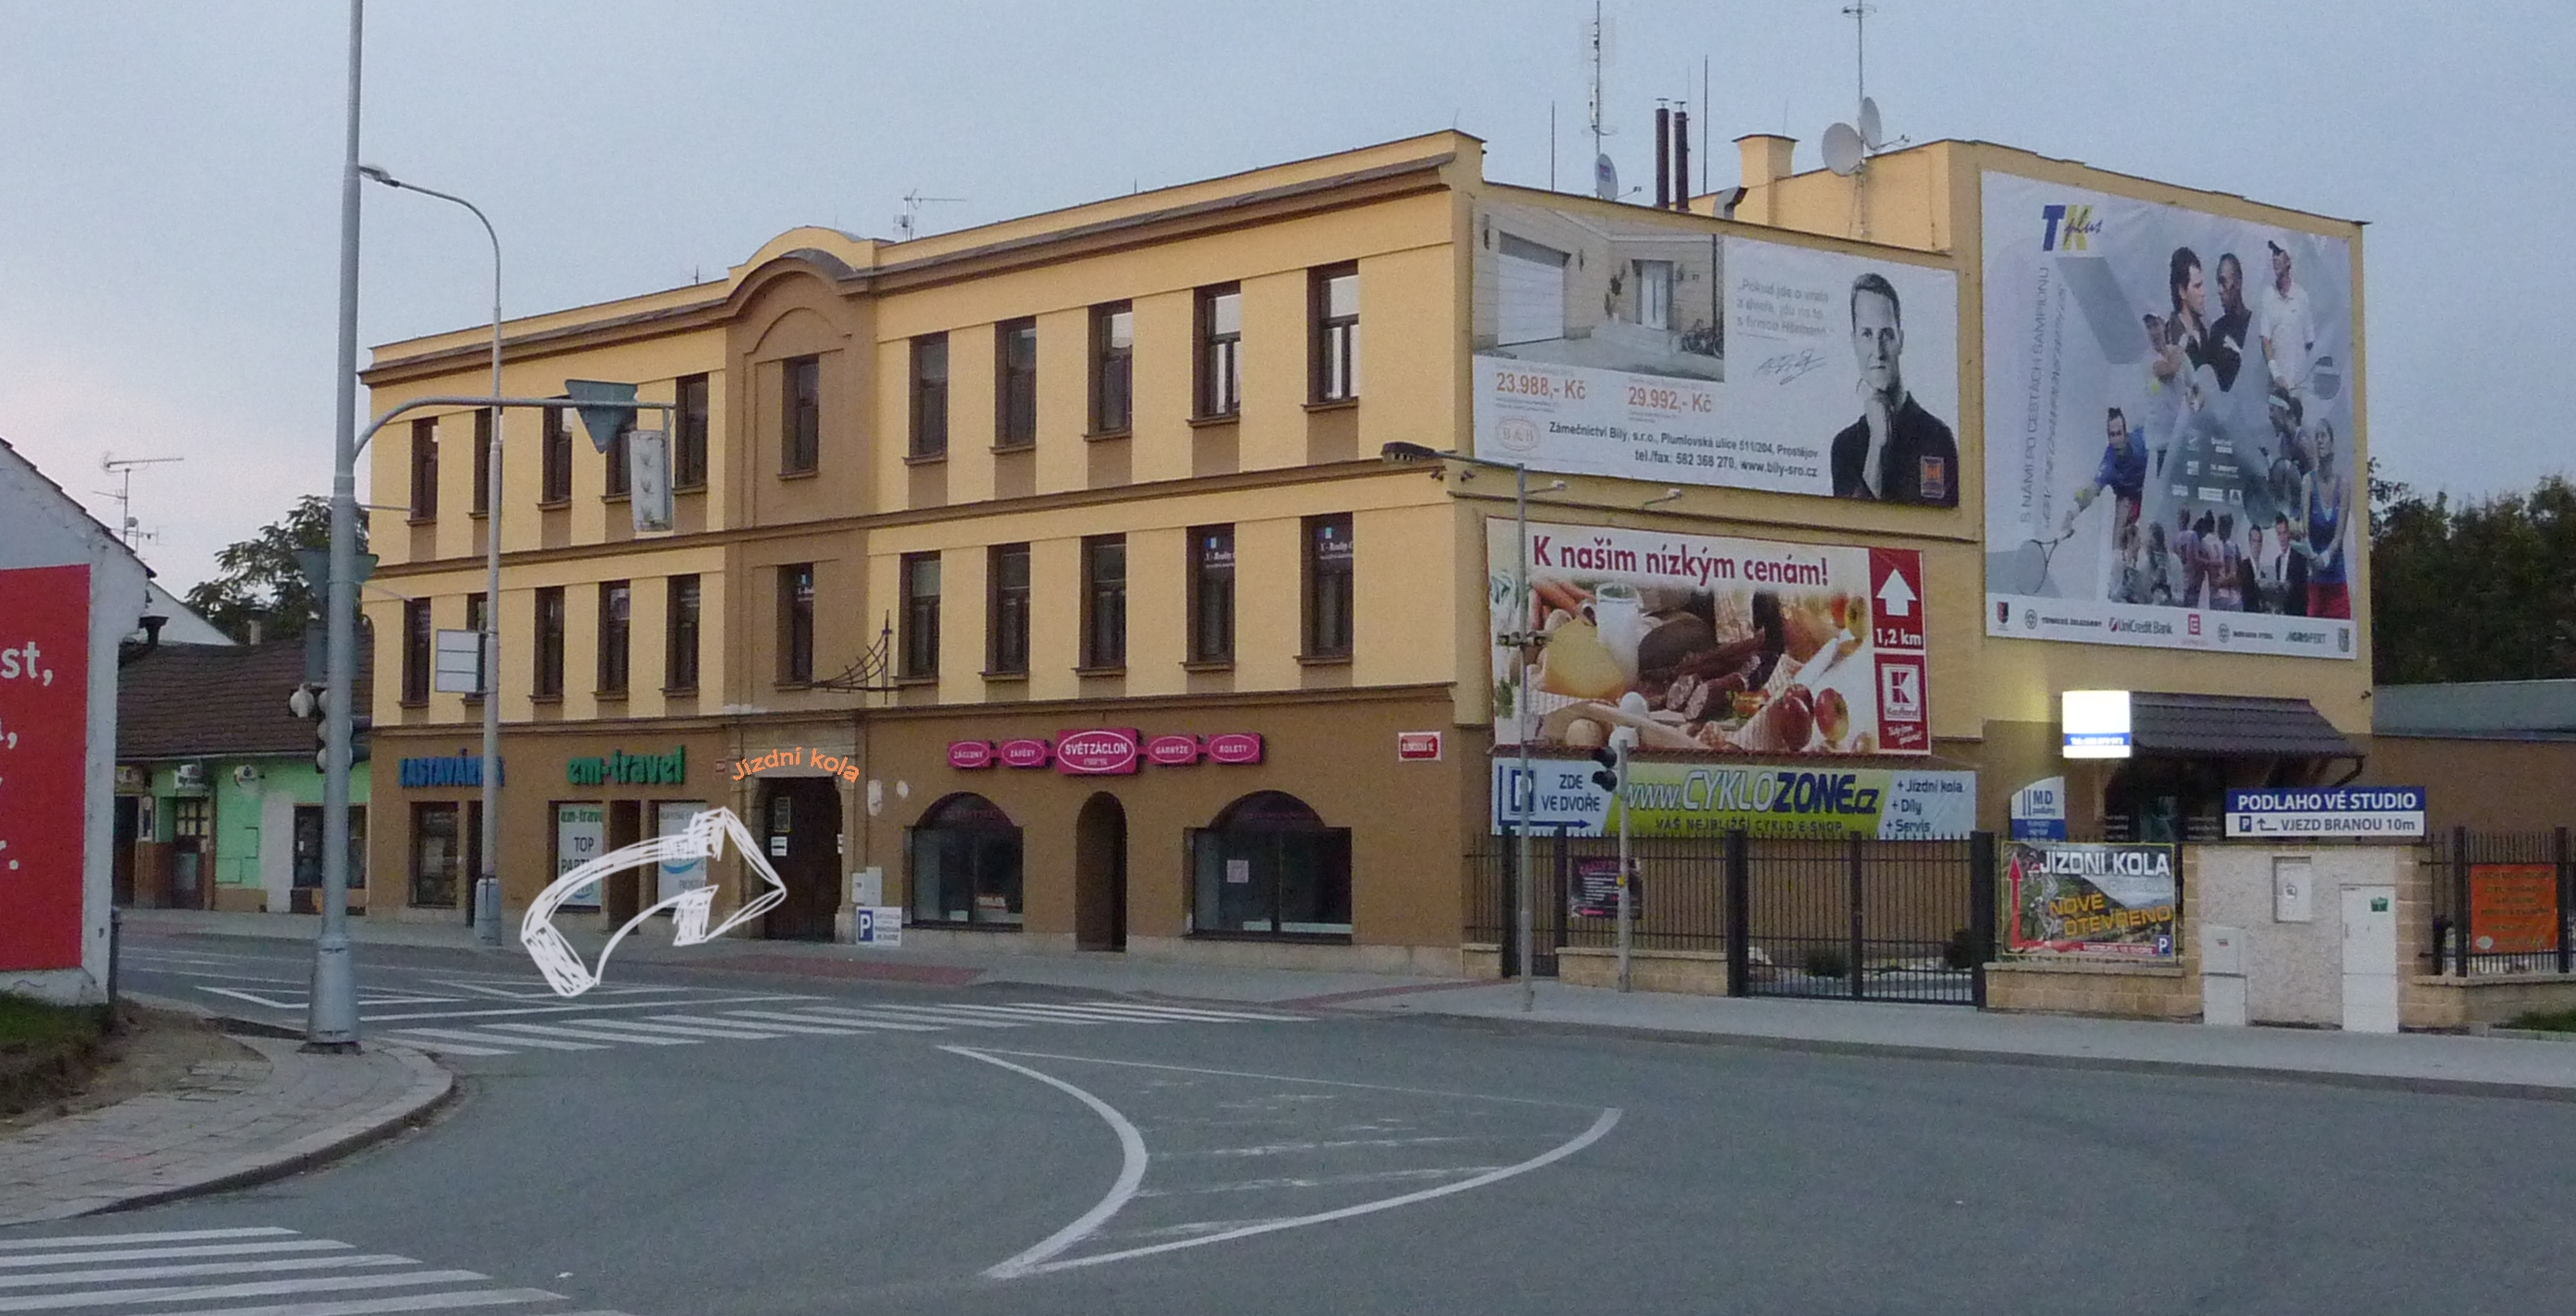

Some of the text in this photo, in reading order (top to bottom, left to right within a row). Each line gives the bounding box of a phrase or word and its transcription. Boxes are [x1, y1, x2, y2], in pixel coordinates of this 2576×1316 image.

[2063, 208, 2103, 247] plus
[1496, 372, 1586, 400] 23.988,- Kč
[1628, 386, 1713, 413] 29.992,- Kč
[1548, 421, 1607, 437] Zámečnictví
[1661, 432, 1714, 448] Plumlovská
[1715, 437, 1737, 450] ulice
[1776, 444, 1819, 460] Prostějov
[1676, 453, 1694, 465] 582
[1697, 454, 1715, 467] 368
[1739, 460, 1818, 477] www.bily-sro.cz
[1533, 536, 1829, 587] K našim nízkým cenám!
[1876, 628, 1921, 646] 1,2 km
[2118, 619, 2173, 635] UniCredit Bank
[1, 641, 53, 686] st,
[1065, 741, 1128, 755] SVĚT ZÁCLON
[397, 748, 505, 787] ZASTAVÁR
[566, 744, 685, 786] em-travel
[1559, 774, 1583, 791] ZDE
[1906, 779, 1938, 793] Jízdní
[1940, 781, 1963, 793] kola
[1541, 791, 1601, 812] VE DVOŘE
[1901, 798, 1922, 815] Díly
[2032, 790, 2053, 805] MD
[2237, 790, 2417, 811] PODLAHO VÉ STUDIO
[1756, 820, 1794, 832] CYKLO
[1896, 818, 1931, 832] Servis
[2242, 817, 2415, 831] P VJEZD BRANOU 10m
[573, 837, 595, 852] TOP
[2039, 846, 2171, 876] JÍZDNÍ KOLA
[2049, 891, 2104, 915] NOVÉ
[860, 913, 872, 939] P
[2063, 905, 2173, 936] OTEVŘENO
[2159, 937, 2168, 952] P
